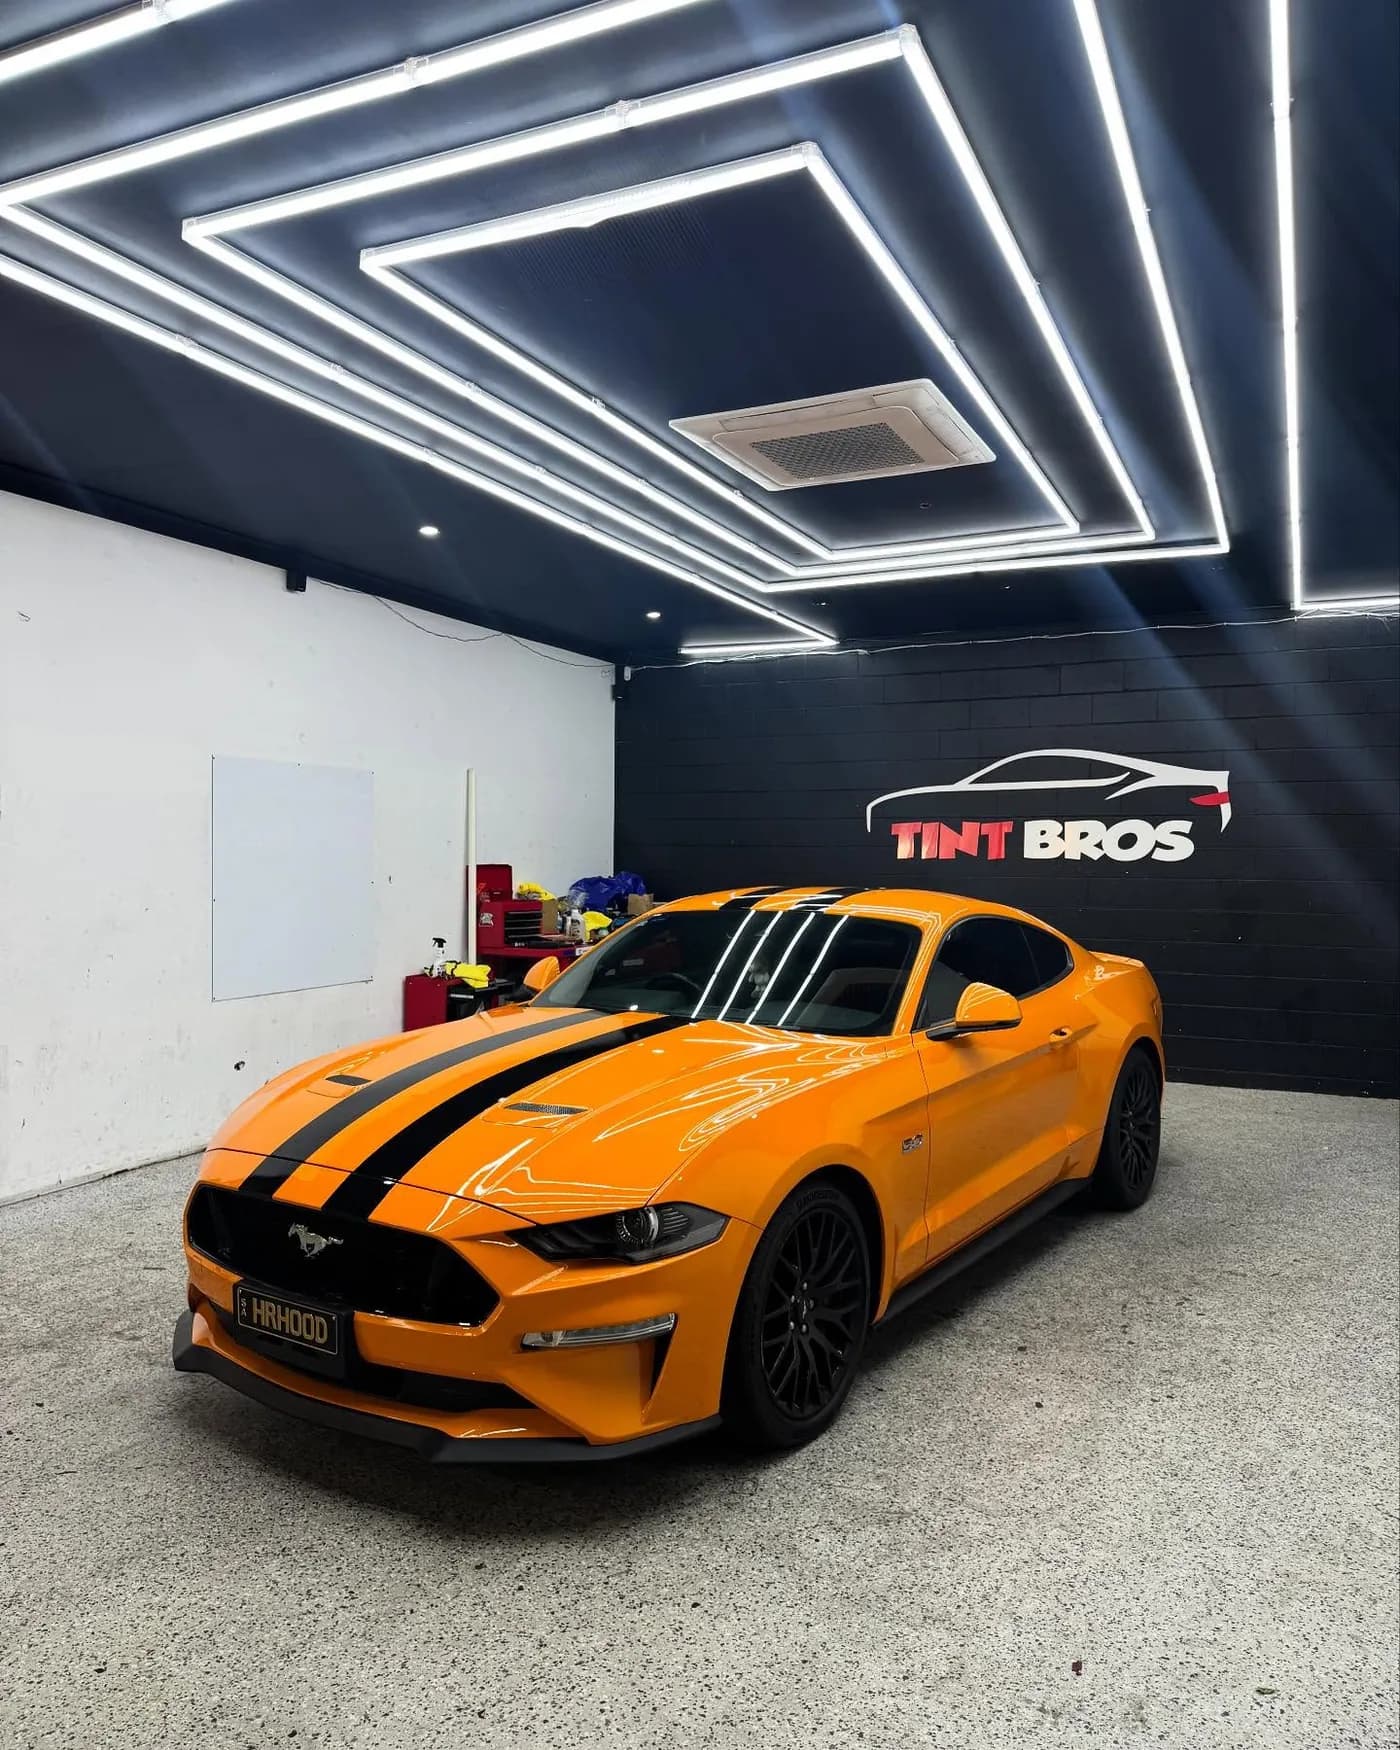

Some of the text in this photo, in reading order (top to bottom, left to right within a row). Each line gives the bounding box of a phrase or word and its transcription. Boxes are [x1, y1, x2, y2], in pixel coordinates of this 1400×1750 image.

[891, 818, 1195, 863] TINT BROS
[252, 1297, 329, 1344] HRHOOD
